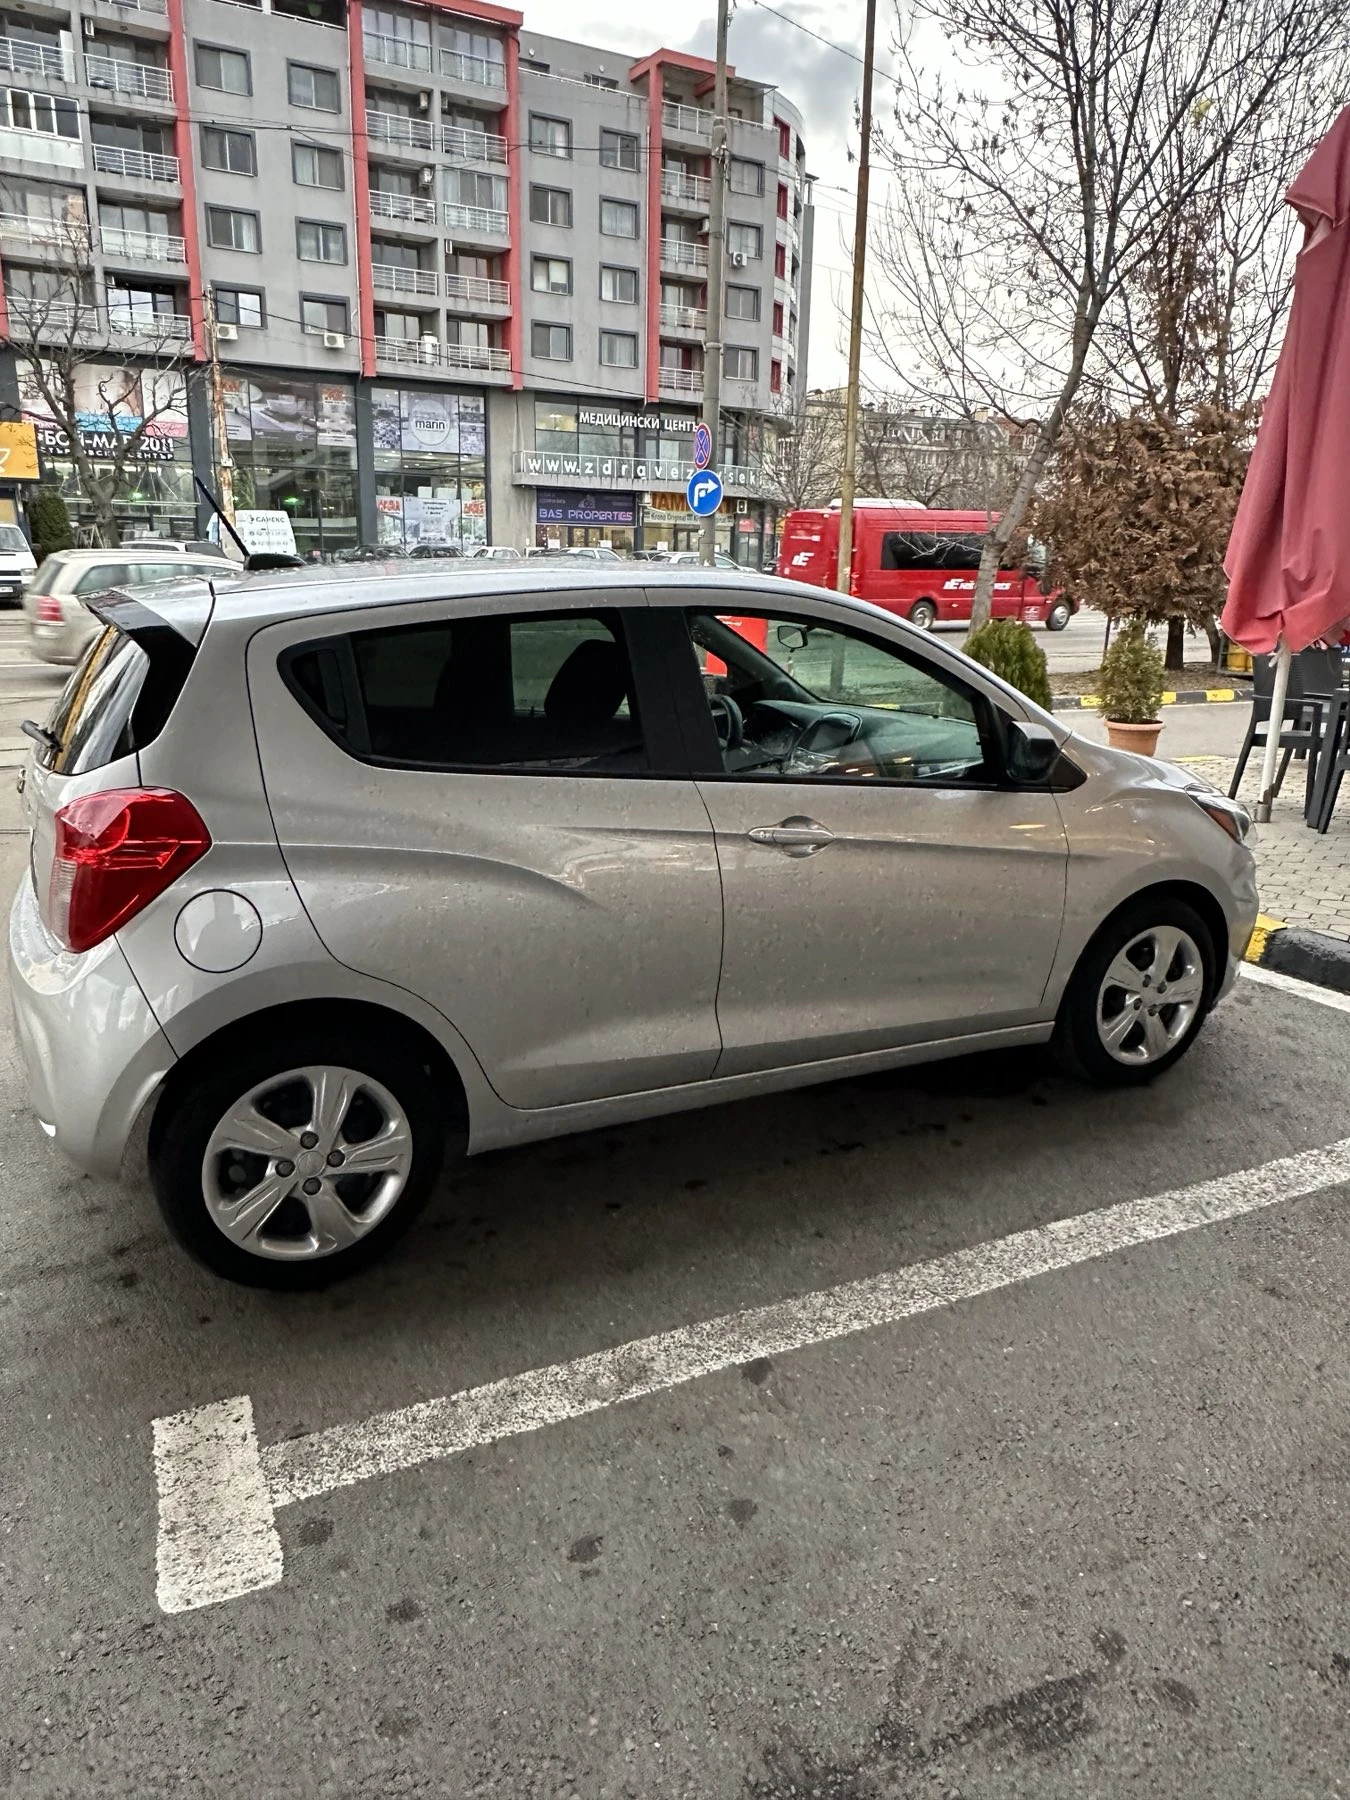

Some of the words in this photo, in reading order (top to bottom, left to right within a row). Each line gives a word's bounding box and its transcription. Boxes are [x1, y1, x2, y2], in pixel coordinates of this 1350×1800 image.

[579, 411, 660, 430] МЕДИЦИНСКИ
[664, 418, 699, 433] ЦЕНТЪ
[140, 435, 174, 452] 2011
[539, 508, 563, 519] BAS
